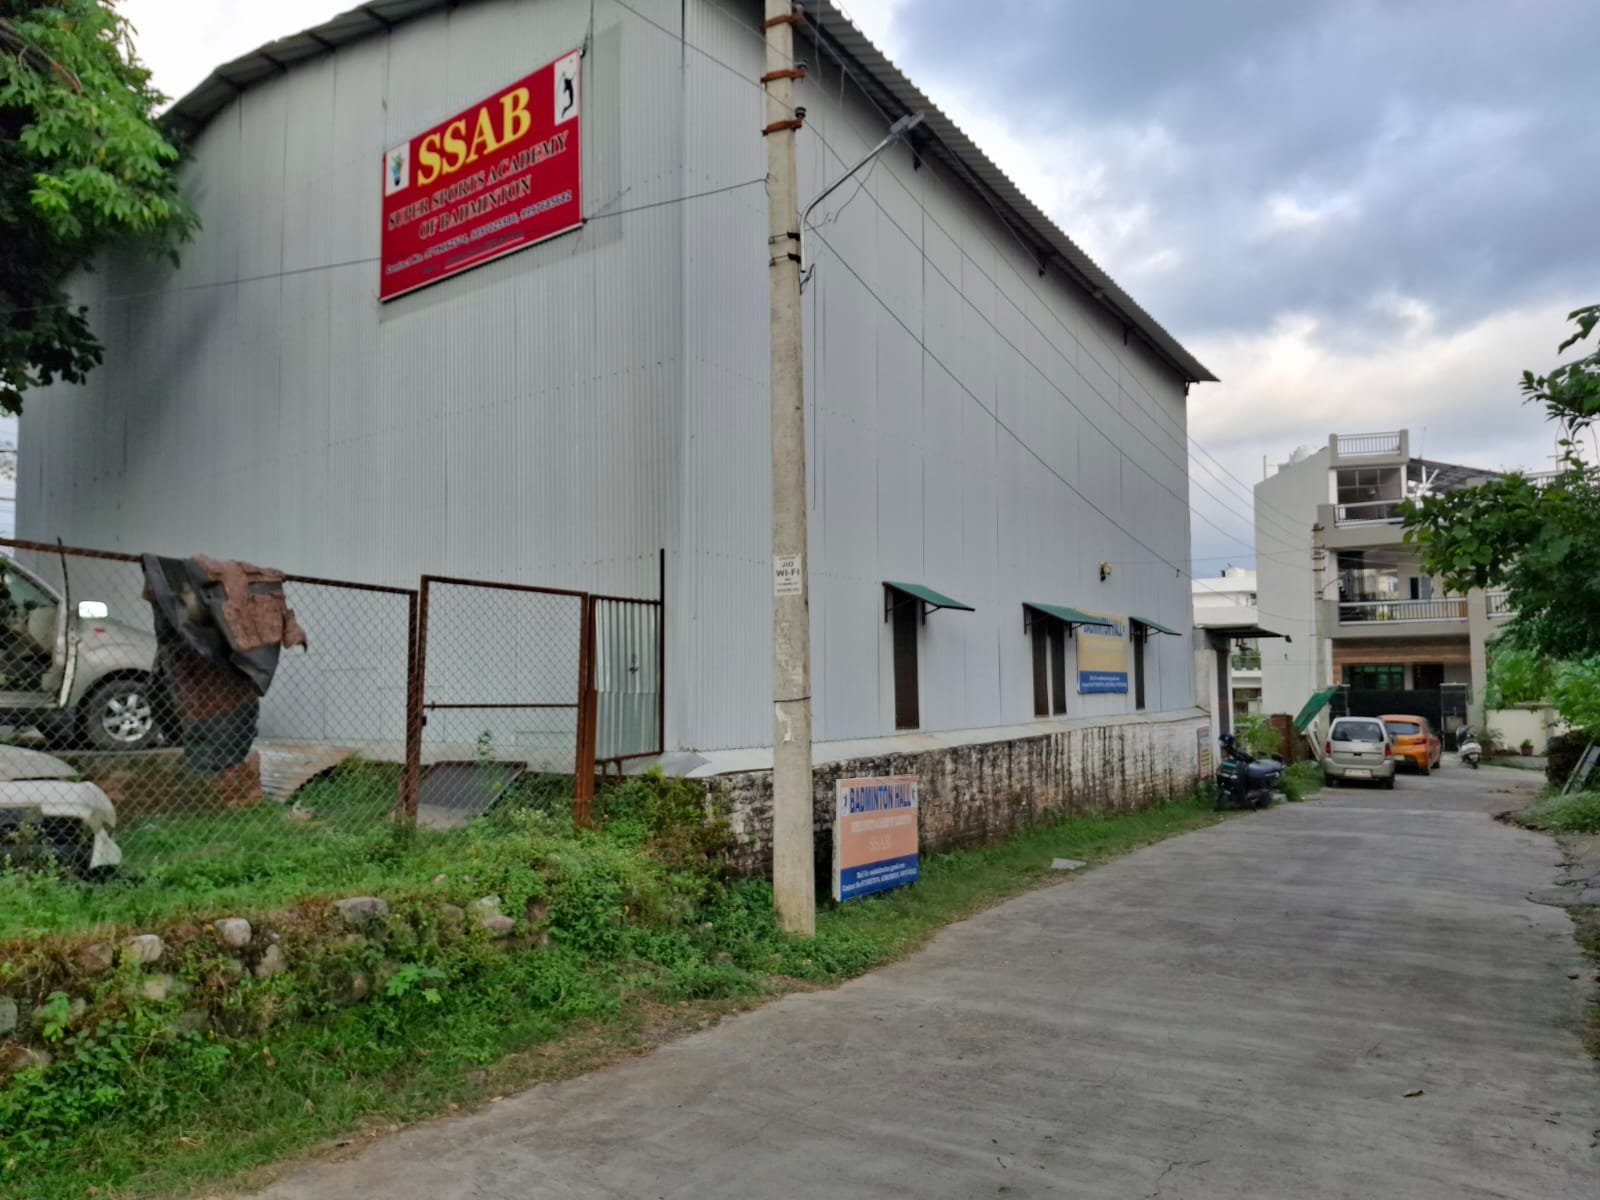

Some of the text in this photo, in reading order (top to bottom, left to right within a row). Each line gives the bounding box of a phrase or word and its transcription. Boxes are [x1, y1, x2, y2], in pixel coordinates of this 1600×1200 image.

[417, 87, 532, 187] SSAB
[388, 196, 431, 231] SUPER
[430, 170, 486, 213] SPORTS
[488, 130, 569, 186] ACADEMY
[418, 218, 440, 240] OF
[440, 174, 532, 231] BADMINTON
[850, 783, 912, 814] BADMINTON HALL
